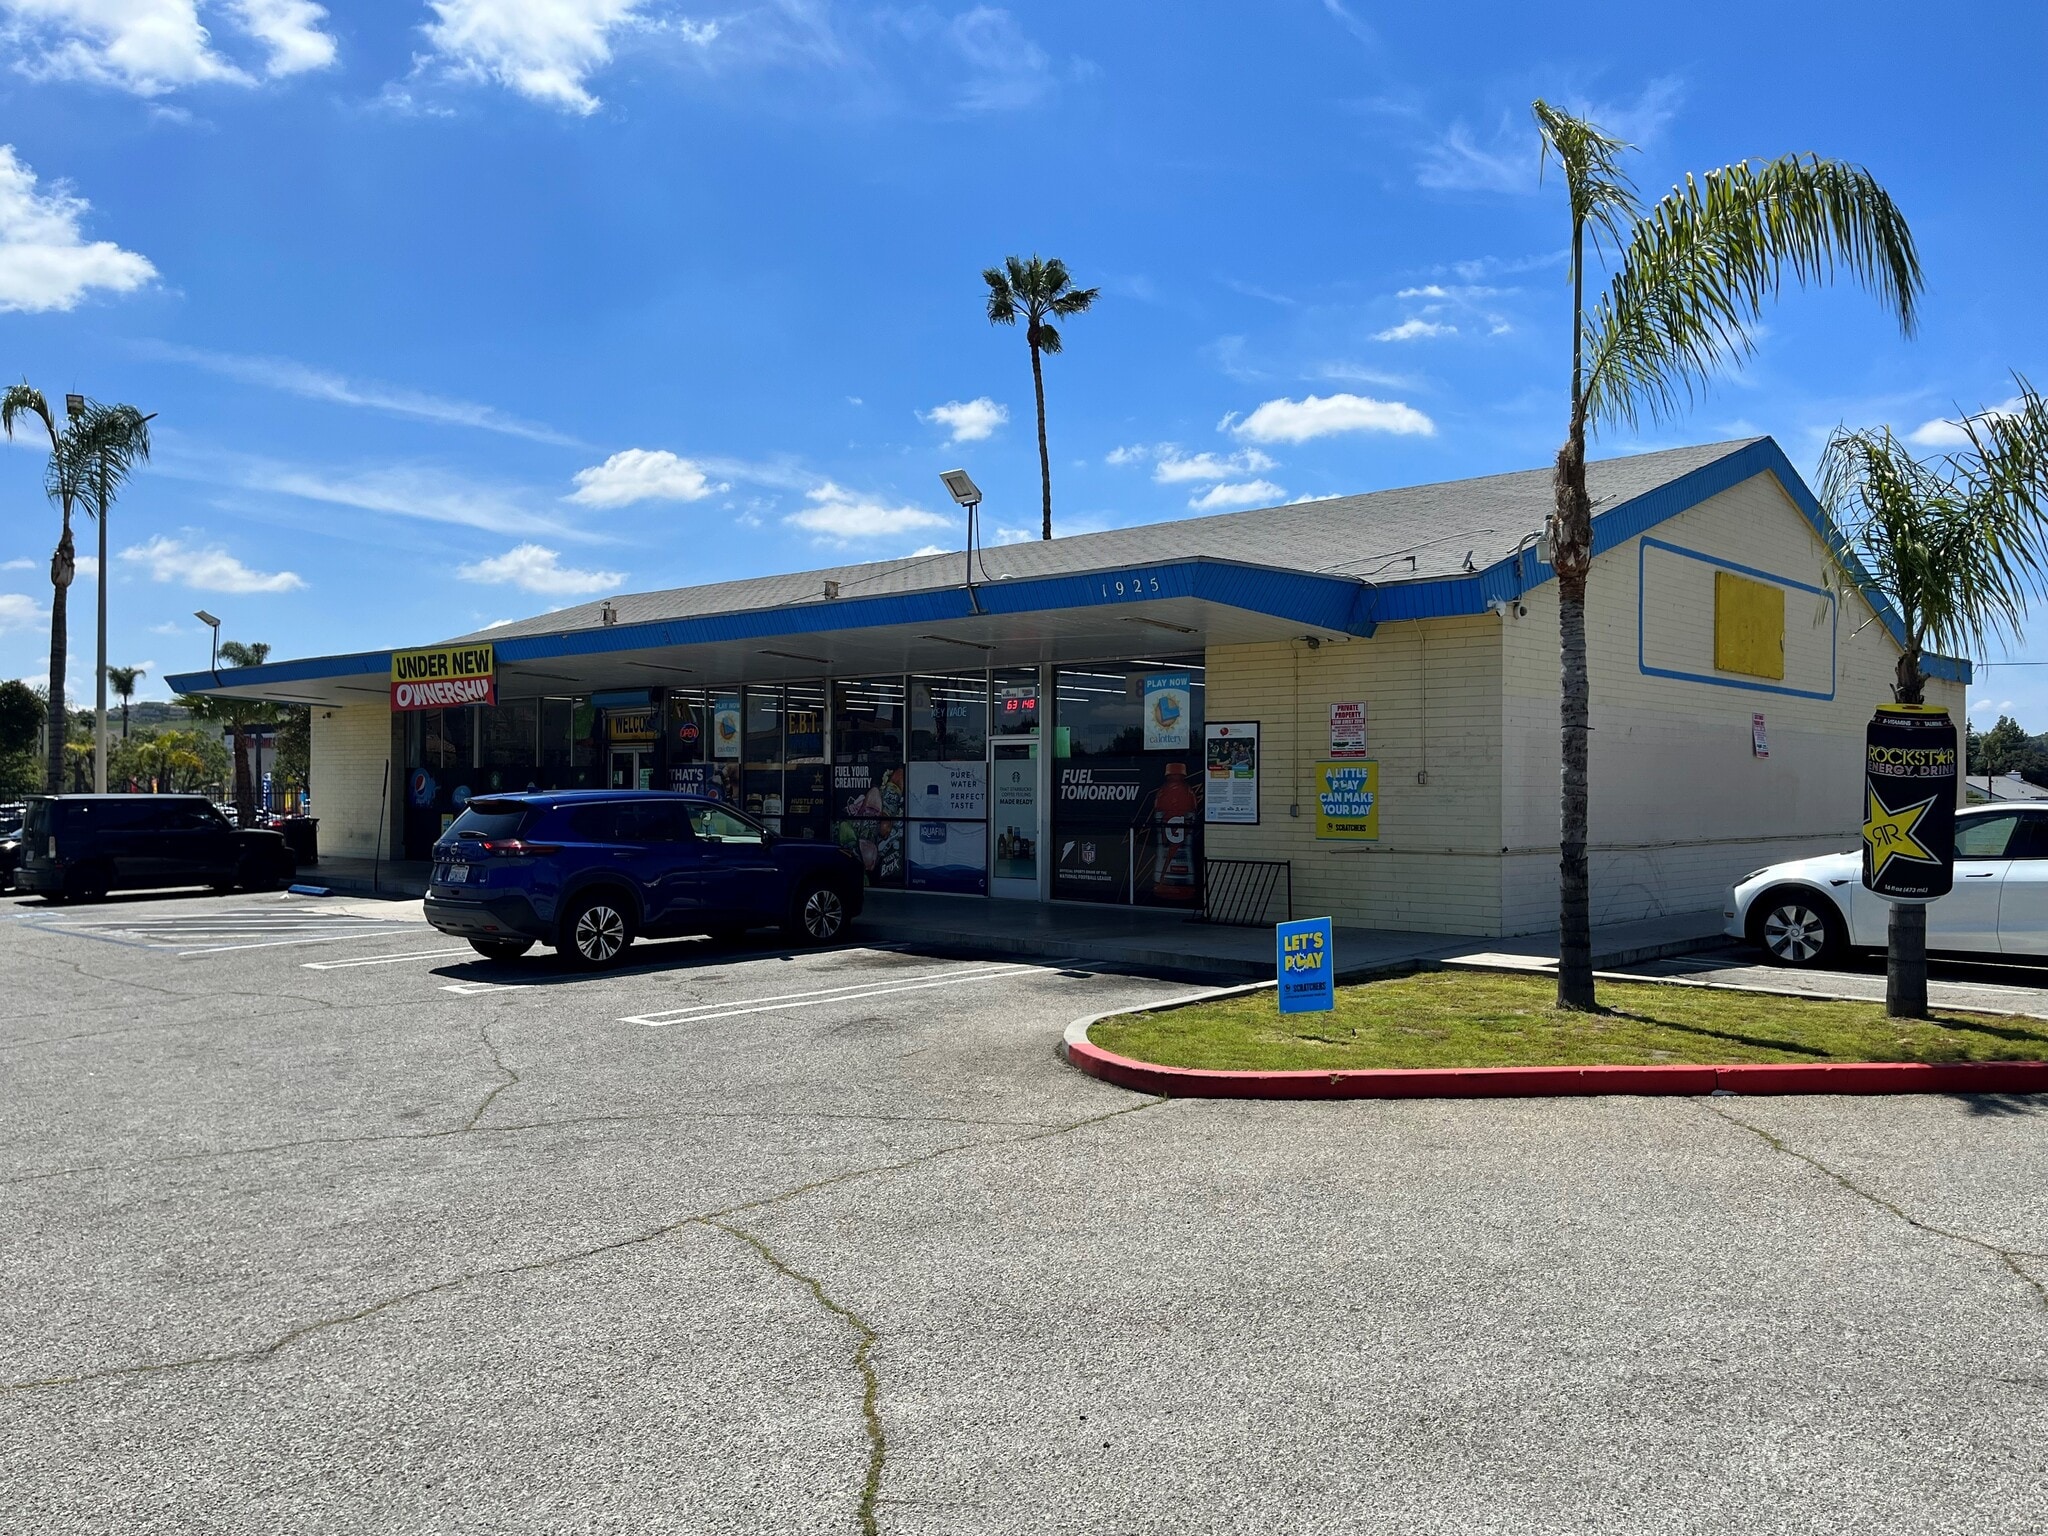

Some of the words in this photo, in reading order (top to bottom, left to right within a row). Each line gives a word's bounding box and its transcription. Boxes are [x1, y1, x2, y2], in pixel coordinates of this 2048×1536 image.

[1102, 577, 1159, 598] 1925
[397, 653, 449, 679] UNDER
[453, 649, 490, 675] NEW
[1147, 679, 1167, 688] PLAY
[1170, 677, 1188, 686] NOW
[1007, 700, 1018, 710] 63
[1022, 699, 1035, 709] 148
[788, 712, 821, 735] E.B.T.
[680, 727, 699, 739] OPEN
[835, 766, 850, 777] FUEL
[851, 766, 870, 777] YOUR
[1326, 768, 1333, 778] A
[1335, 768, 1368, 778] LITTLE
[1868, 761, 1914, 776] ENERGY
[1920, 763, 1956, 776] DRINK
[669, 768, 704, 782] THAT'S
[950, 771, 970, 779] PURE
[1061, 768, 1094, 784] FUEL
[835, 777, 872, 789] CREATIVITY
[950, 780, 977, 788] WATER
[1060, 785, 1140, 801] TOMORROW
[1320, 792, 1341, 802] CAN
[1344, 792, 1374, 802] MAKE
[1322, 804, 1350, 815] YOUR
[1352, 804, 1371, 815] DAY
[1335, 824, 1367, 832] SCRATCHERS
[1284, 931, 1324, 952] LET'S
[1294, 982, 1327, 992] SCRATCHERS
